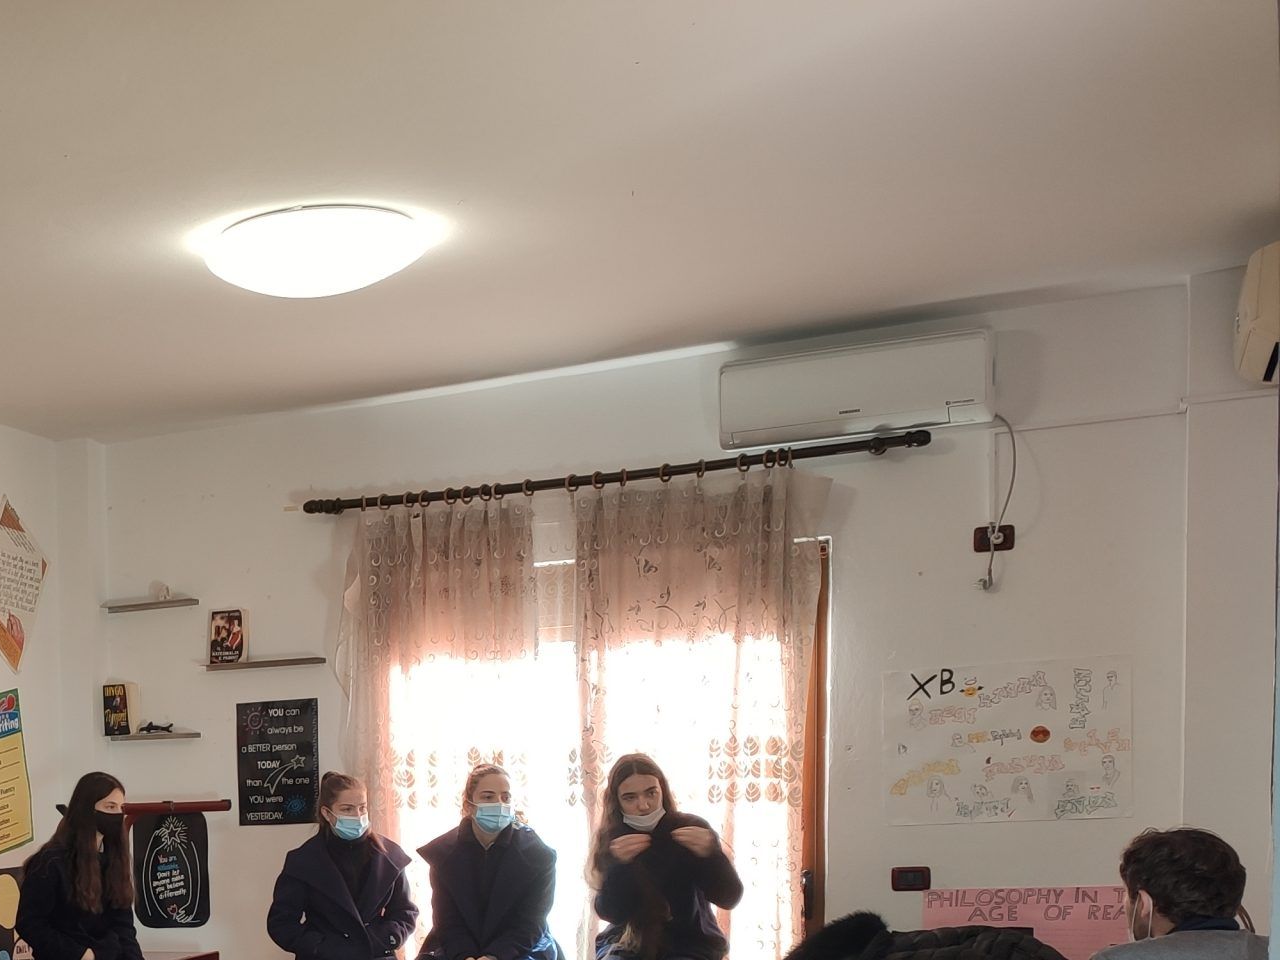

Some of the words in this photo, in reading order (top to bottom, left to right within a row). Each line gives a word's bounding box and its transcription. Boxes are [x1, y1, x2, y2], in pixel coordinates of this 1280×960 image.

[267, 726, 292, 734] always
[248, 744, 270, 752] BETTER
[272, 743, 296, 752] person
[257, 760, 280, 769] TODAY
[247, 812, 283, 820] YESTERDAY.
[928, 889, 1064, 908] PHILOSOPHY
[968, 906, 1017, 921] AGE
[1044, 905, 1073, 920] OF
